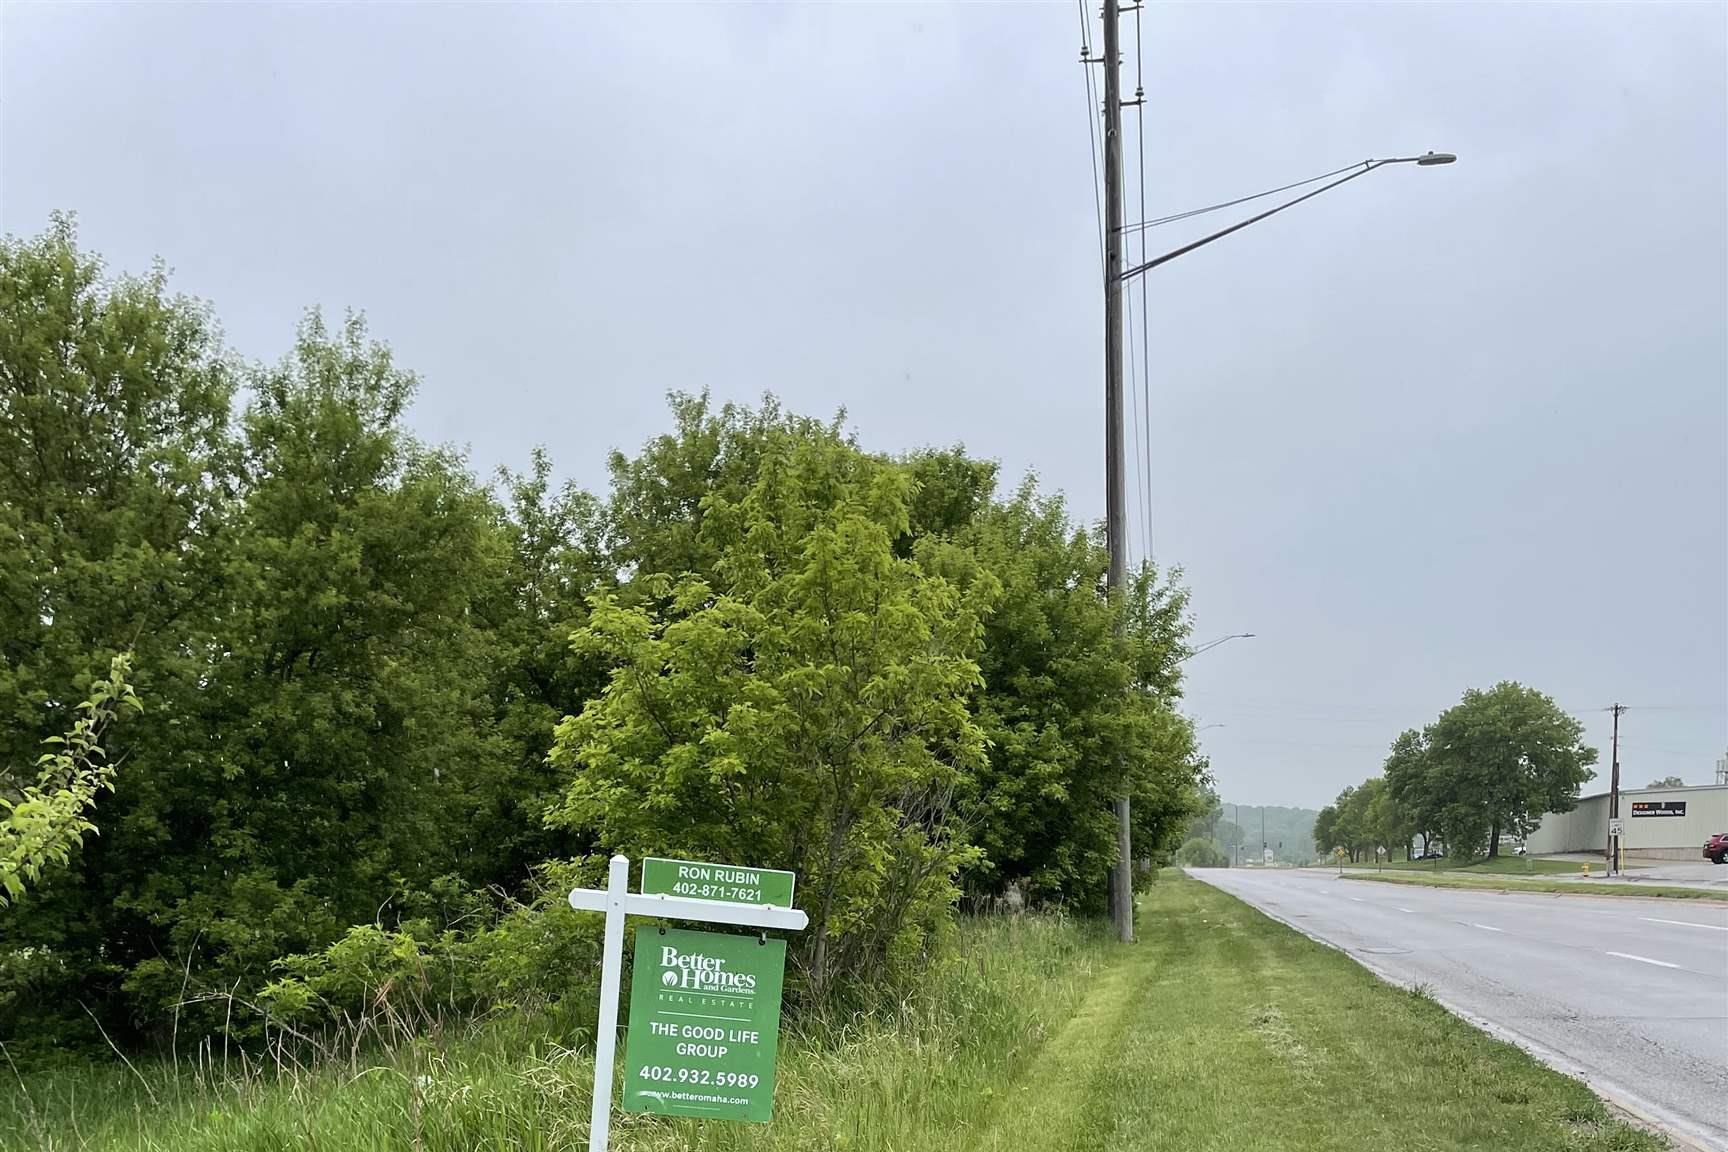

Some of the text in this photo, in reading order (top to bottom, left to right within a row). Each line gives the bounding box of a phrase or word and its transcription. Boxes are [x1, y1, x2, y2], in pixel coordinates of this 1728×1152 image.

[678, 866, 760, 885] RON RUBIN
[673, 882, 761, 901] 402-871-7621
[660, 946, 725, 971] Better
[680, 968, 756, 990] Homes
[703, 984, 719, 992] and
[659, 994, 753, 1009] REAL ESTATE
[650, 1022, 759, 1044] THE GOOD LIFE
[676, 1042, 728, 1058] GROUP
[639, 1065, 759, 1089] 402.932.5989
[647, 1090, 749, 1105] ww.betteromaha.com
